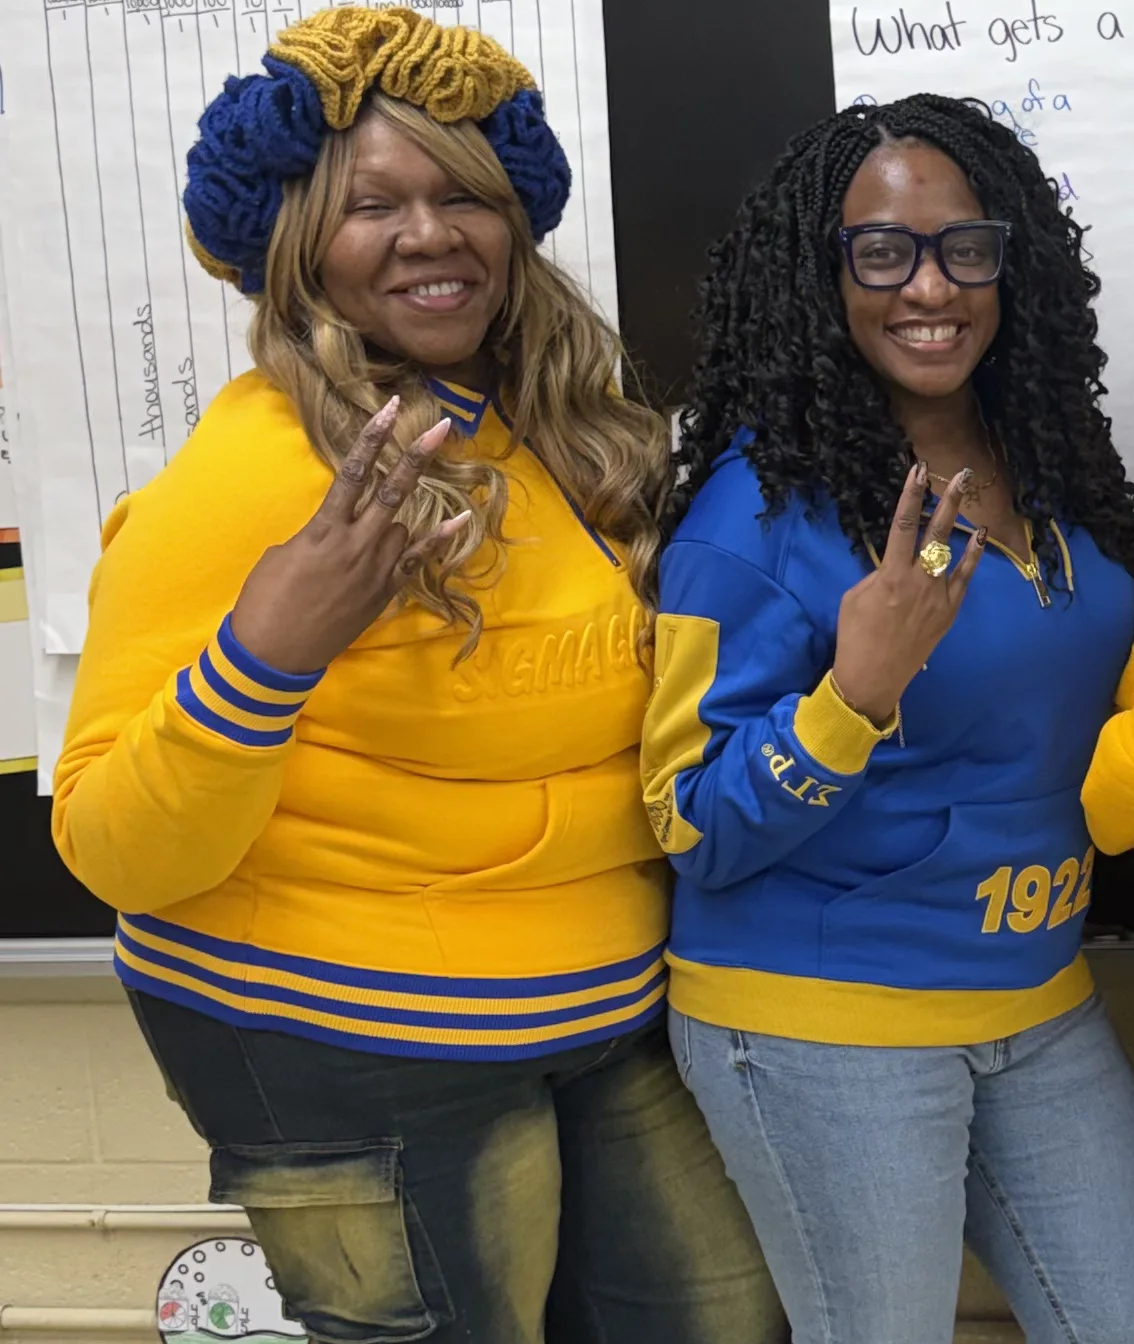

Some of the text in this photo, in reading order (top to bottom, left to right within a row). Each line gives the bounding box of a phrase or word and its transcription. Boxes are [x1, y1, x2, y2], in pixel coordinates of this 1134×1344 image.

[851, 0, 967, 56] What
[1097, 11, 1125, 40] a
[1021, 78, 1072, 113] of a
[133, 303, 163, 441] thousands
[975, 845, 1095, 935] 1922
